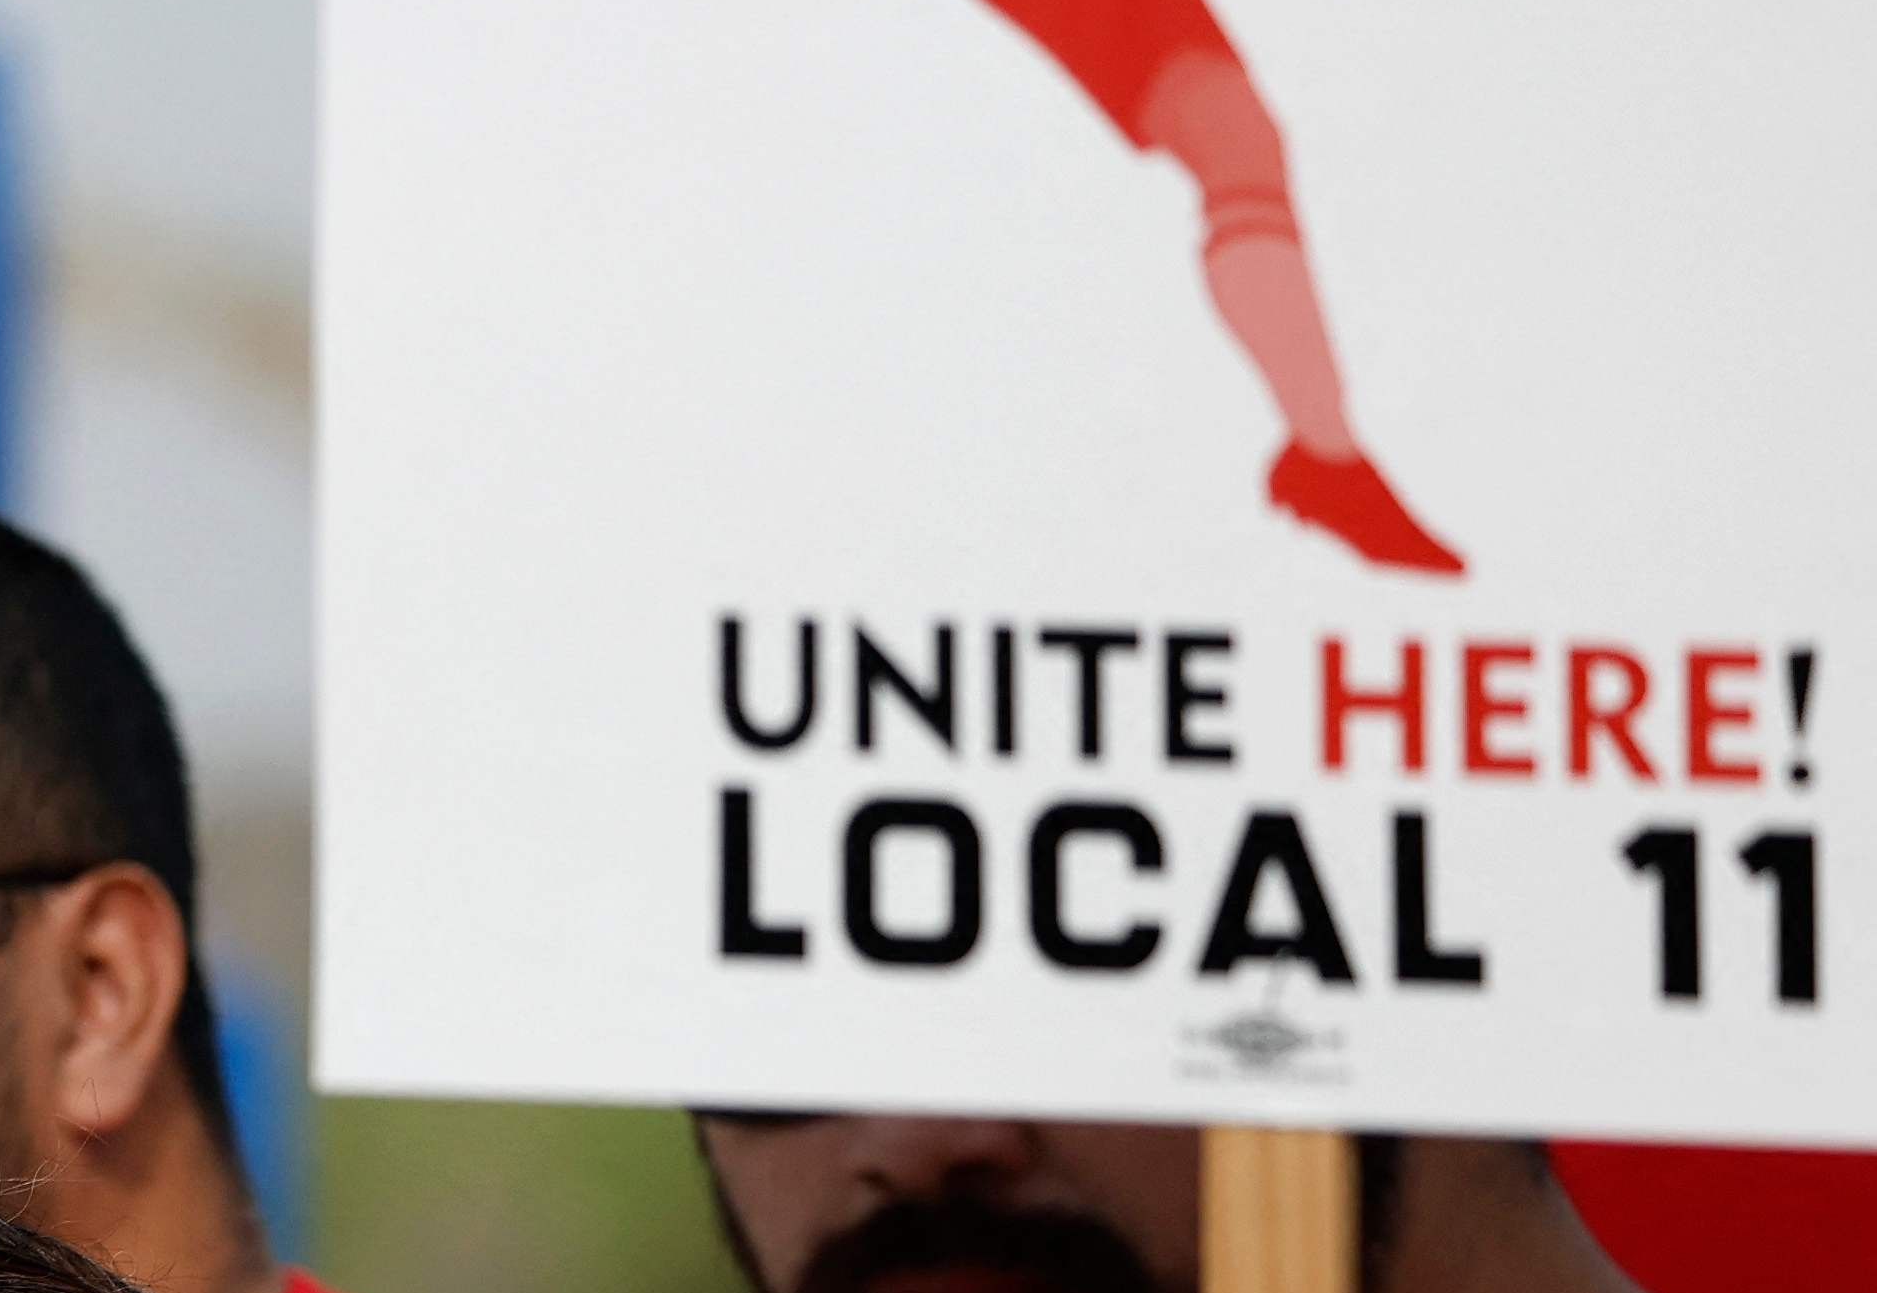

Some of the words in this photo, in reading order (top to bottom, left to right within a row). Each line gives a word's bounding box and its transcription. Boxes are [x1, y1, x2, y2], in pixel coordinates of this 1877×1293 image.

[720, 617, 1236, 765] UNITE
[1321, 638, 1816, 787] HERE!
[718, 786, 1486, 989] LOCAL
[1621, 825, 1819, 1007] 11
